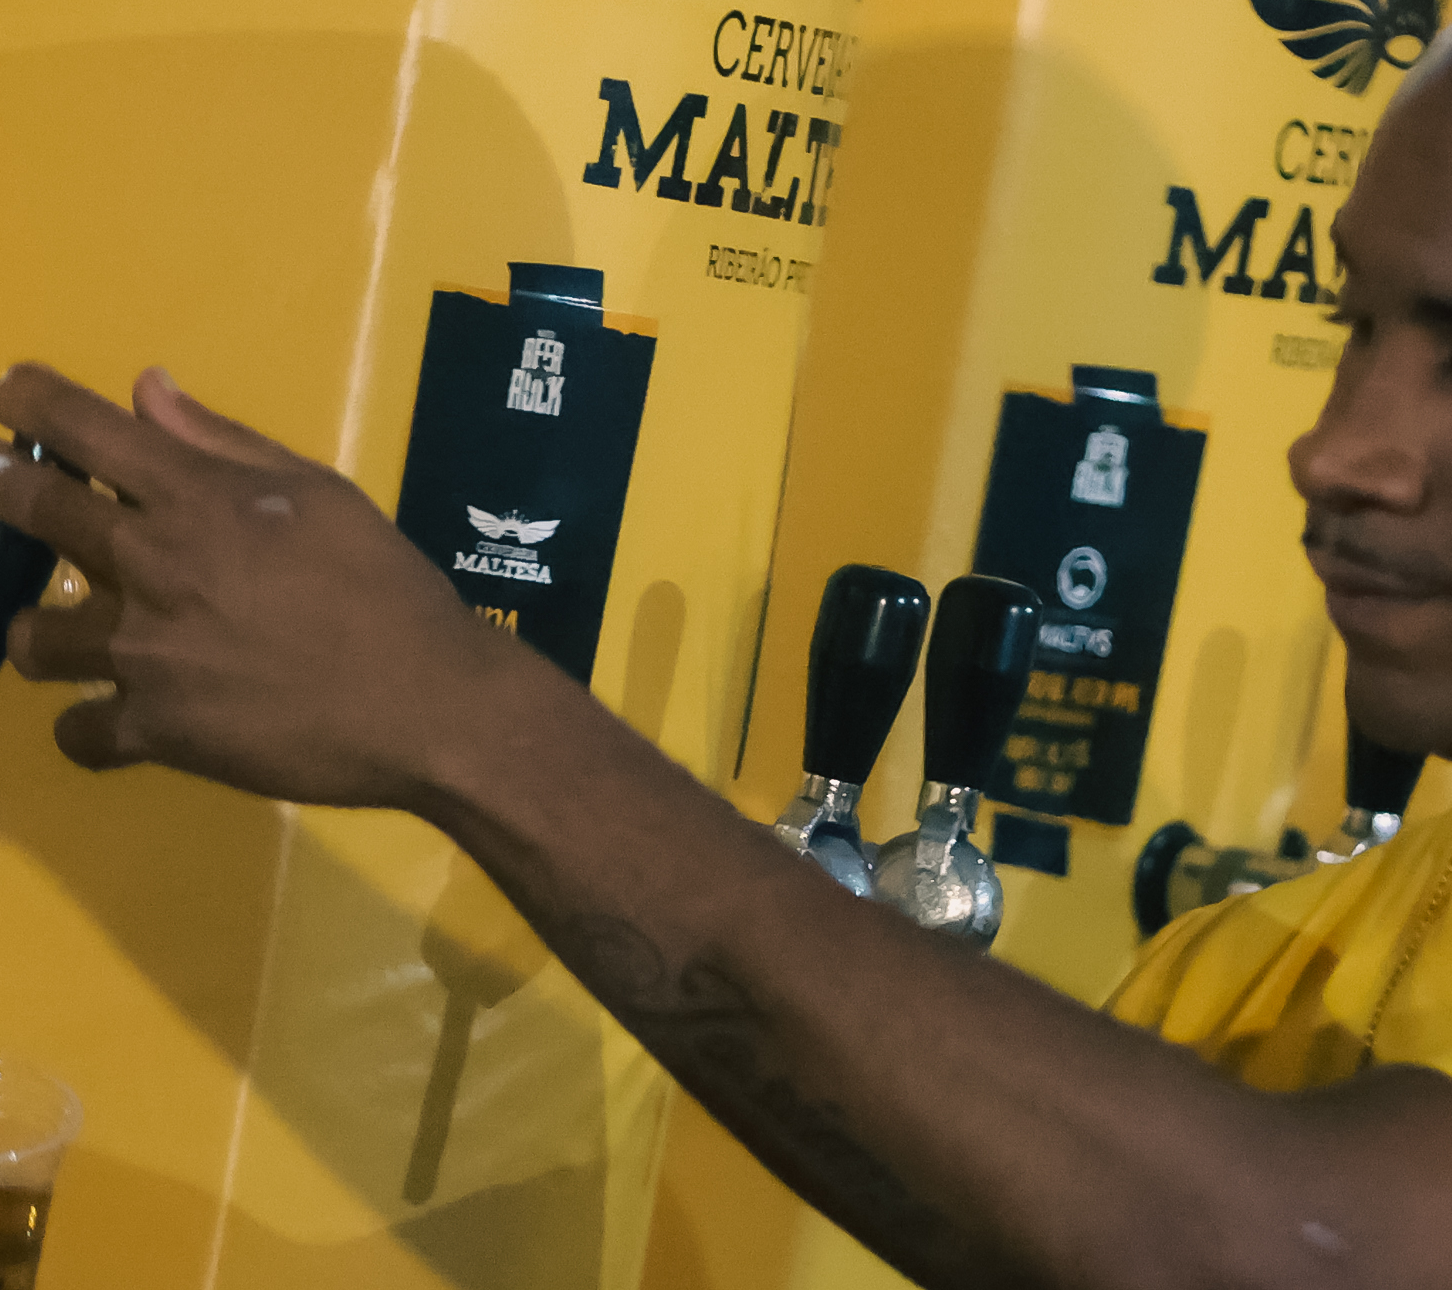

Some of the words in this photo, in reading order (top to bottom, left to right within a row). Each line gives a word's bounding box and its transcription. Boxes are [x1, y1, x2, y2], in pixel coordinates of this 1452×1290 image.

[582, 77, 843, 227] MALT
[1153, 186, 1338, 306] MA
[453, 551, 552, 585] MALTESA
